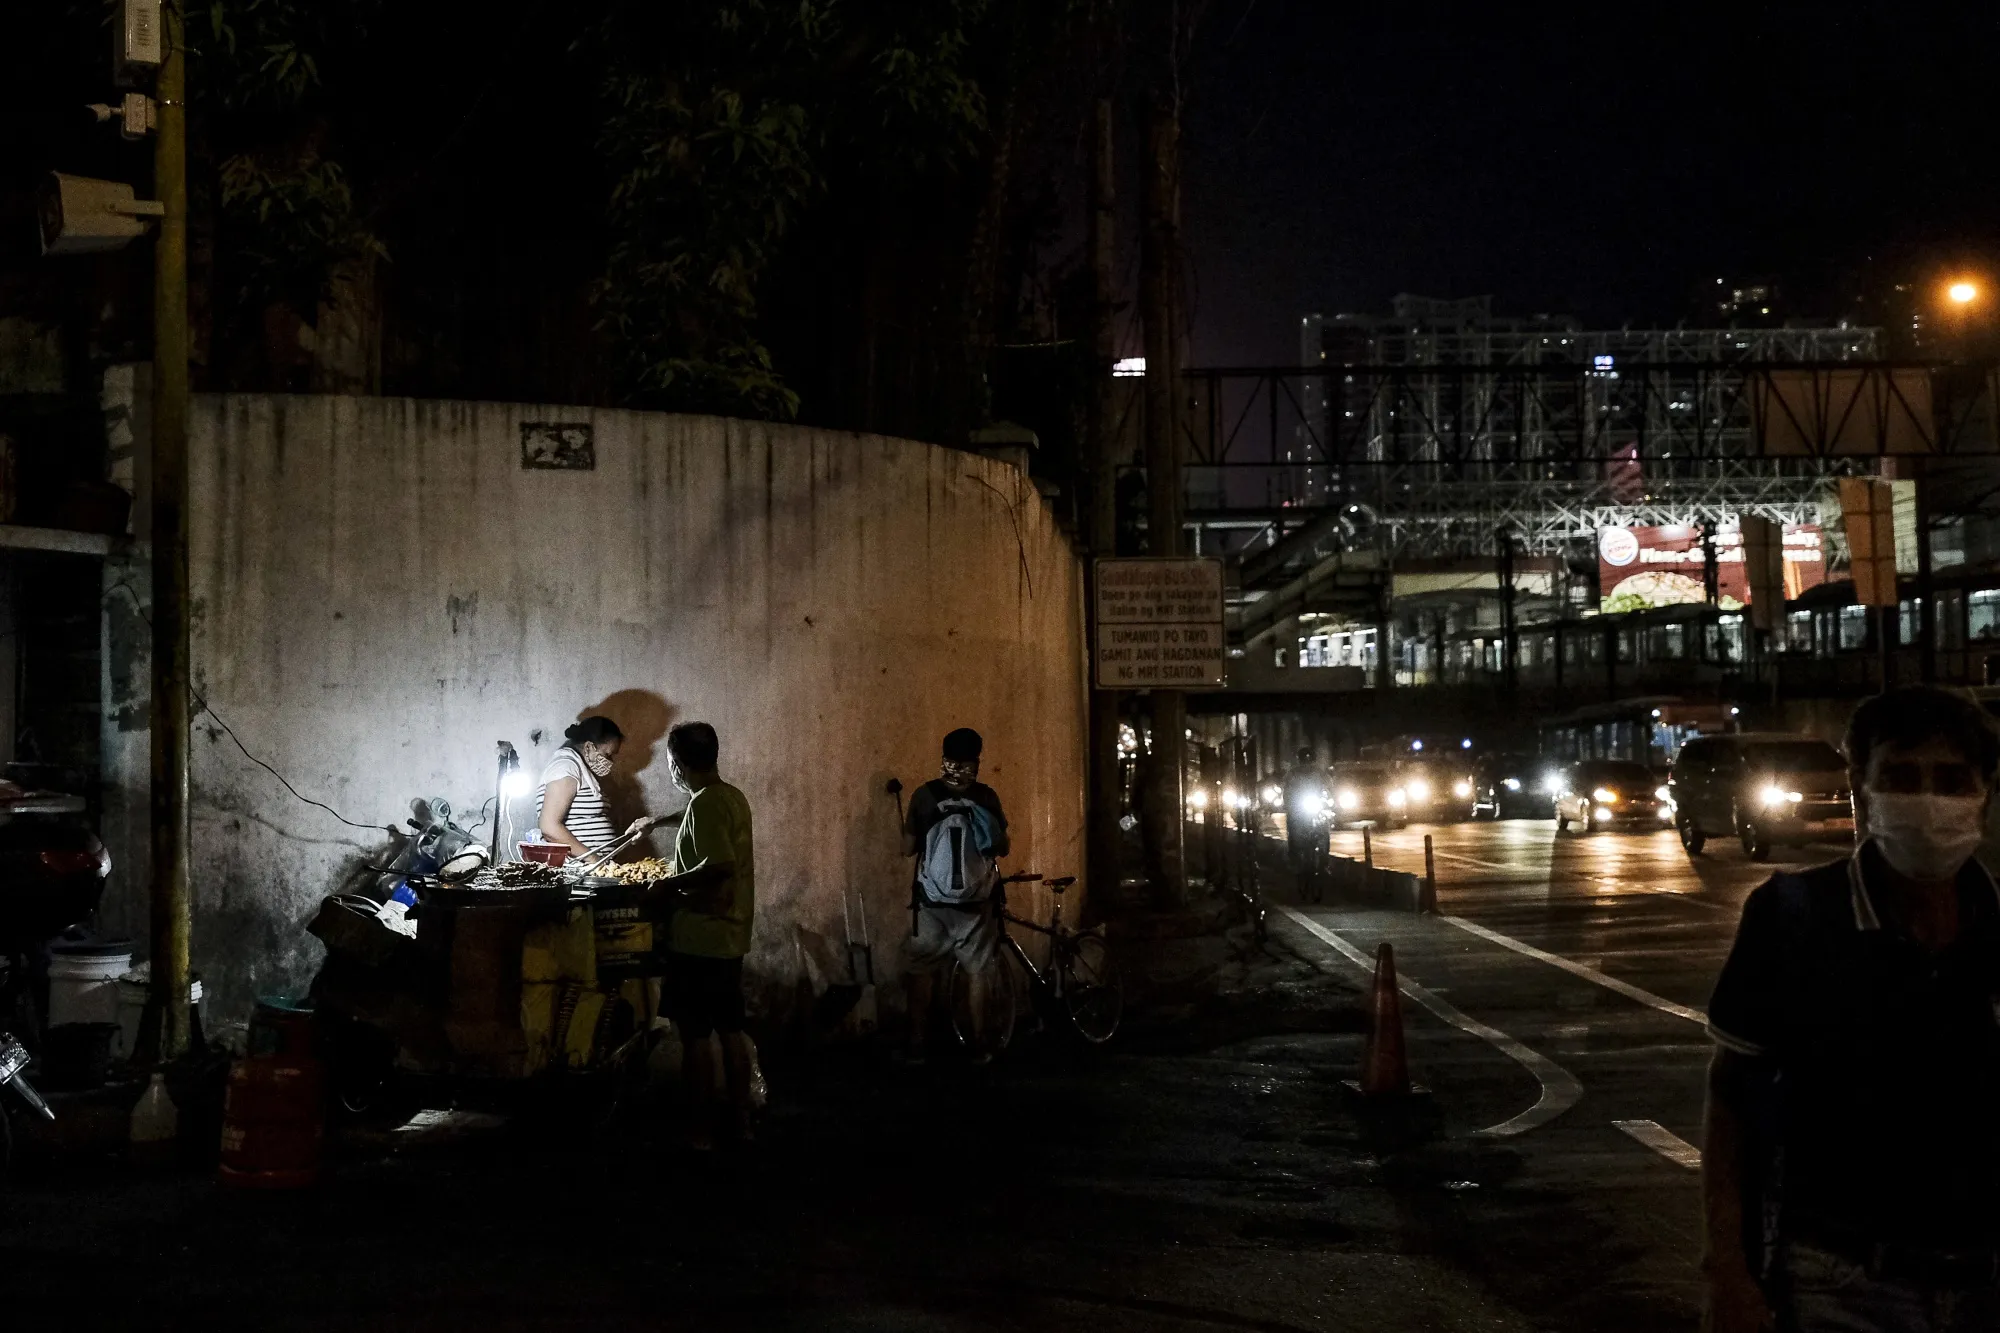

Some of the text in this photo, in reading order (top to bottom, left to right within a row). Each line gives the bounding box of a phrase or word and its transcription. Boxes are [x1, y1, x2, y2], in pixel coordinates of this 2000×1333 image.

[1163, 630, 1179, 642] PO
[1183, 630, 1208, 642] TAYO
[1101, 648, 1132, 661] GAMIT
[1136, 648, 1158, 660] ANG
[1118, 665, 1204, 678] NG MRT STATION
